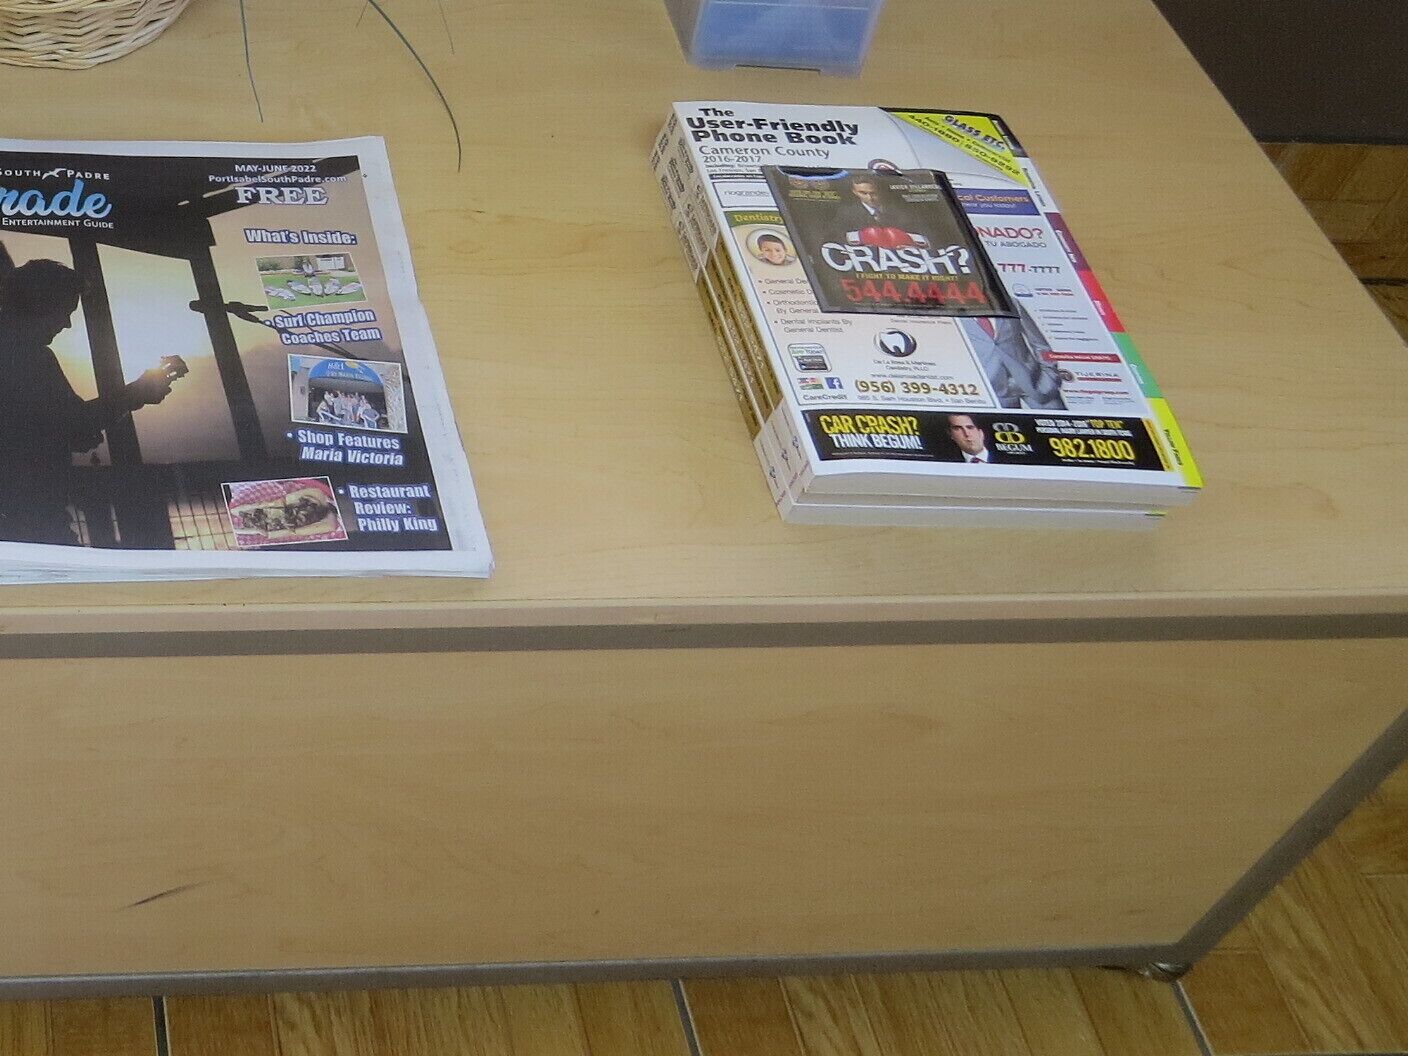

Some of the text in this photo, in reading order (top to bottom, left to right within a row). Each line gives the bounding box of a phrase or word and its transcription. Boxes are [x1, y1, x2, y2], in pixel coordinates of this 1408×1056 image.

[698, 108, 734, 118] The
[686, 117, 859, 136] User-Friendly
[944, 115, 981, 136] GLASS
[692, 129, 858, 146] Phone Book
[699, 145, 830, 159] Cameron County
[703, 156, 762, 164] 2016-2017
[291, 164, 317, 173] 2022
[208, 175, 347, 184] PortIsabelSouthPadre.com
[234, 186, 330, 205] FREE
[975, 194, 1030, 202] Customers
[734, 214, 783, 223] Dentistry
[244, 229, 358, 245] What's Inside:
[976, 227, 1043, 239] NADO?
[821, 243, 971, 275] CRASH?
[274, 309, 376, 329] Surf Champion
[281, 327, 382, 345] Coaches Team
[855, 380, 980, 396] (956) 399-4312
[819, 415, 920, 435] CAR CRASH?
[297, 429, 400, 450] Shop Features
[830, 434, 923, 450] THINK BEGUM!
[995, 443, 1033, 452] BEGUM
[301, 446, 404, 466] Maria Victoria
[1049, 437, 1136, 460] 982.1800
[349, 484, 431, 499] Restaurant
[354, 501, 412, 515] Review:
[358, 517, 438, 532] Philly King
